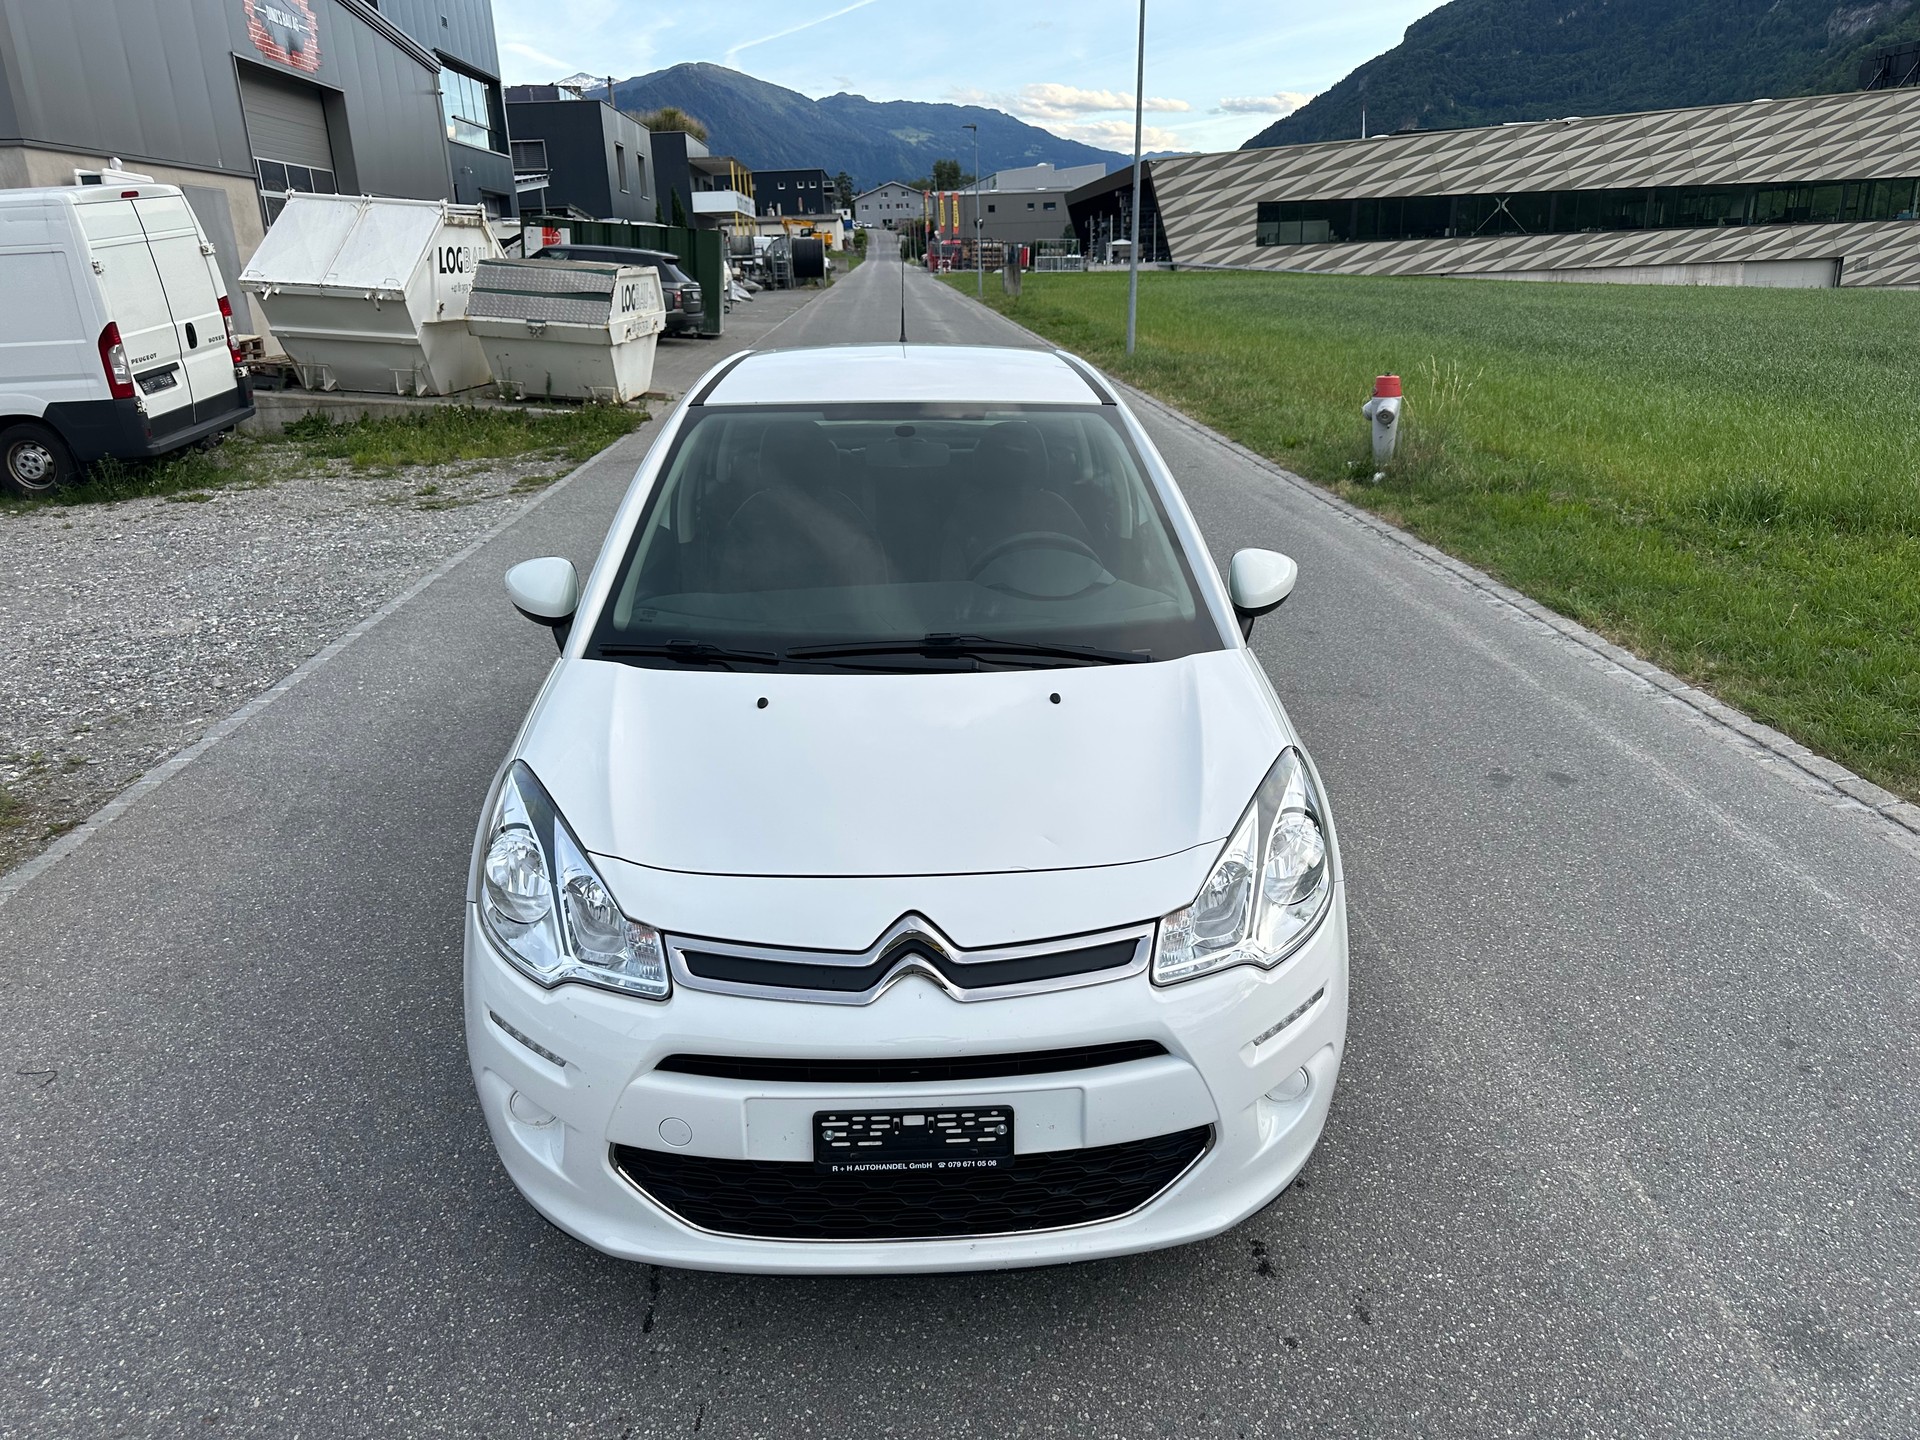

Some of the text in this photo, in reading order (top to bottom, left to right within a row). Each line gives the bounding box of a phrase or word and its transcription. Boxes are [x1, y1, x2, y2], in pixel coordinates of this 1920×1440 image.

[208, 334, 225, 344] BOXER
[131, 352, 157, 364] PEUGEOT
[854, 1163, 908, 1172] AUTOHANDEL
[909, 1162, 933, 1170] GmbH
[947, 1160, 961, 1168] 079
